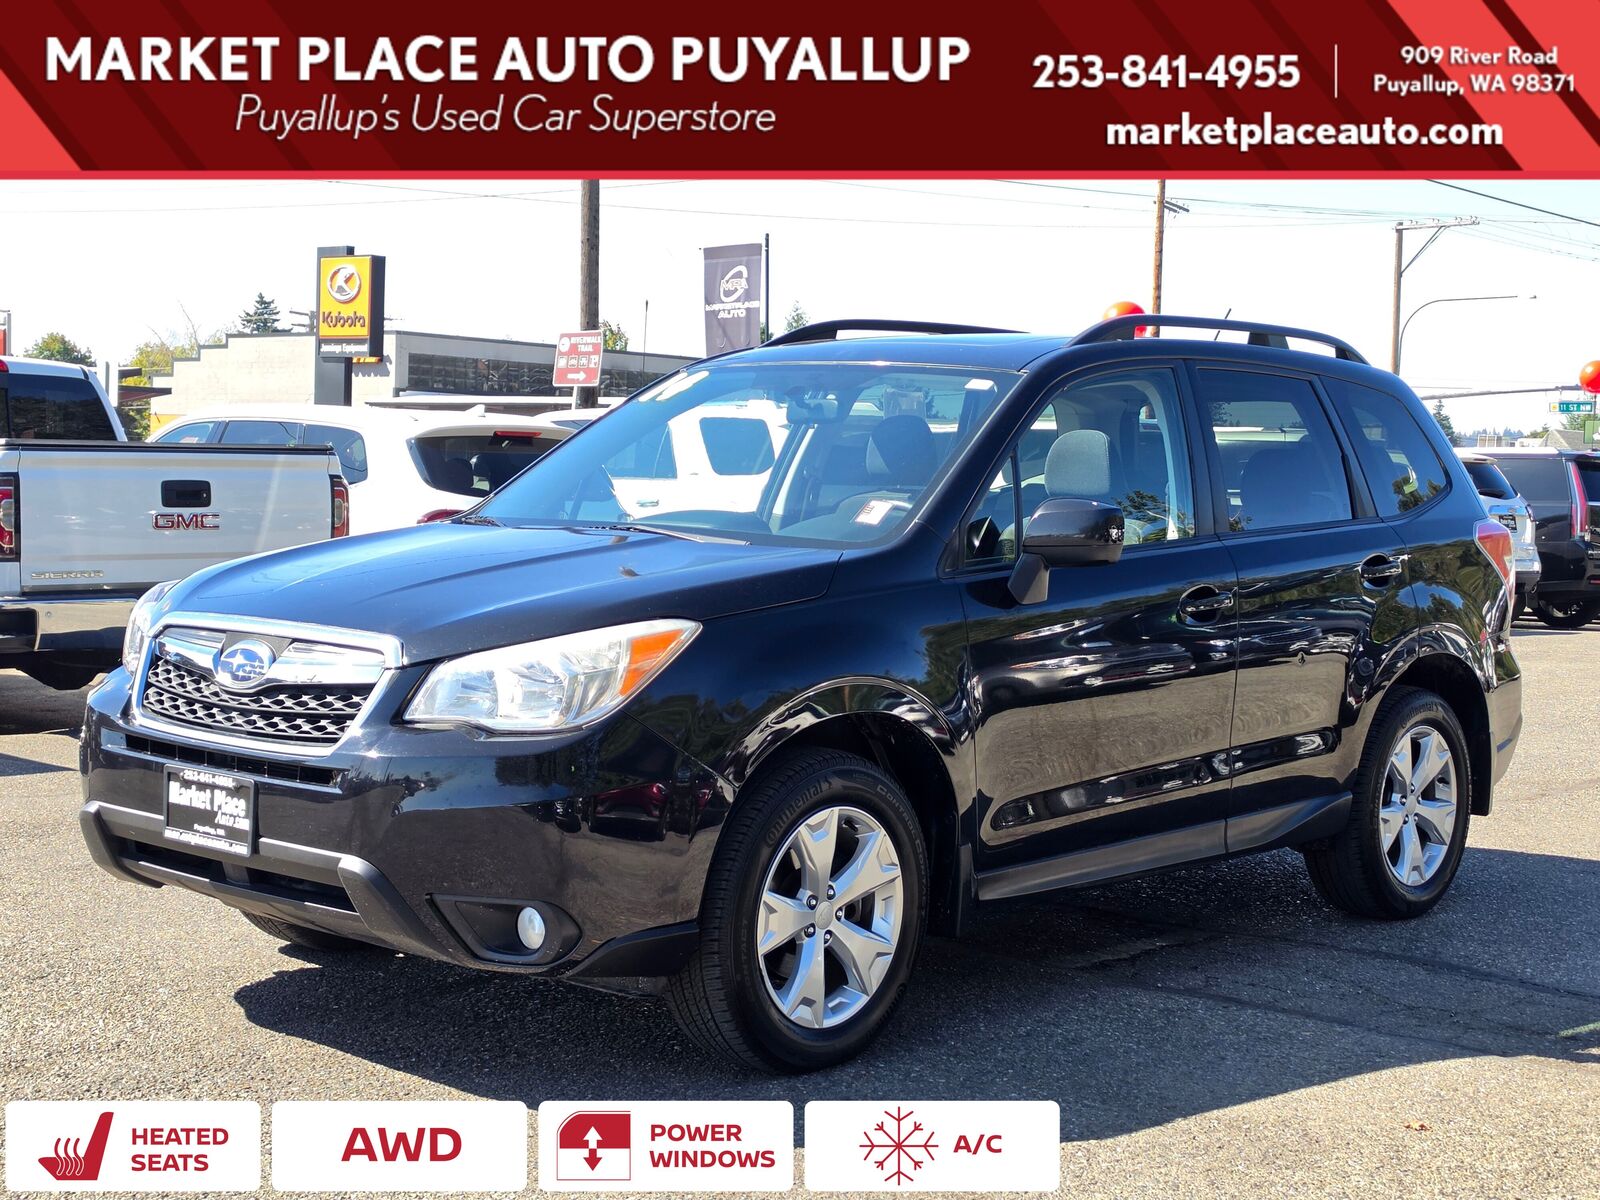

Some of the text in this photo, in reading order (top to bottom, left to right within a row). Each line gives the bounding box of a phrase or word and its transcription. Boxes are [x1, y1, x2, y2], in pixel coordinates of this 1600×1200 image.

[321, 311, 366, 328] Kubota
[718, 309, 746, 319] AUTO
[578, 344, 593, 352] TRAIL
[152, 513, 220, 531] GMC
[31, 570, 104, 580] SIERRA
[168, 780, 246, 818] Market Place
[766, 778, 824, 848] Continental
